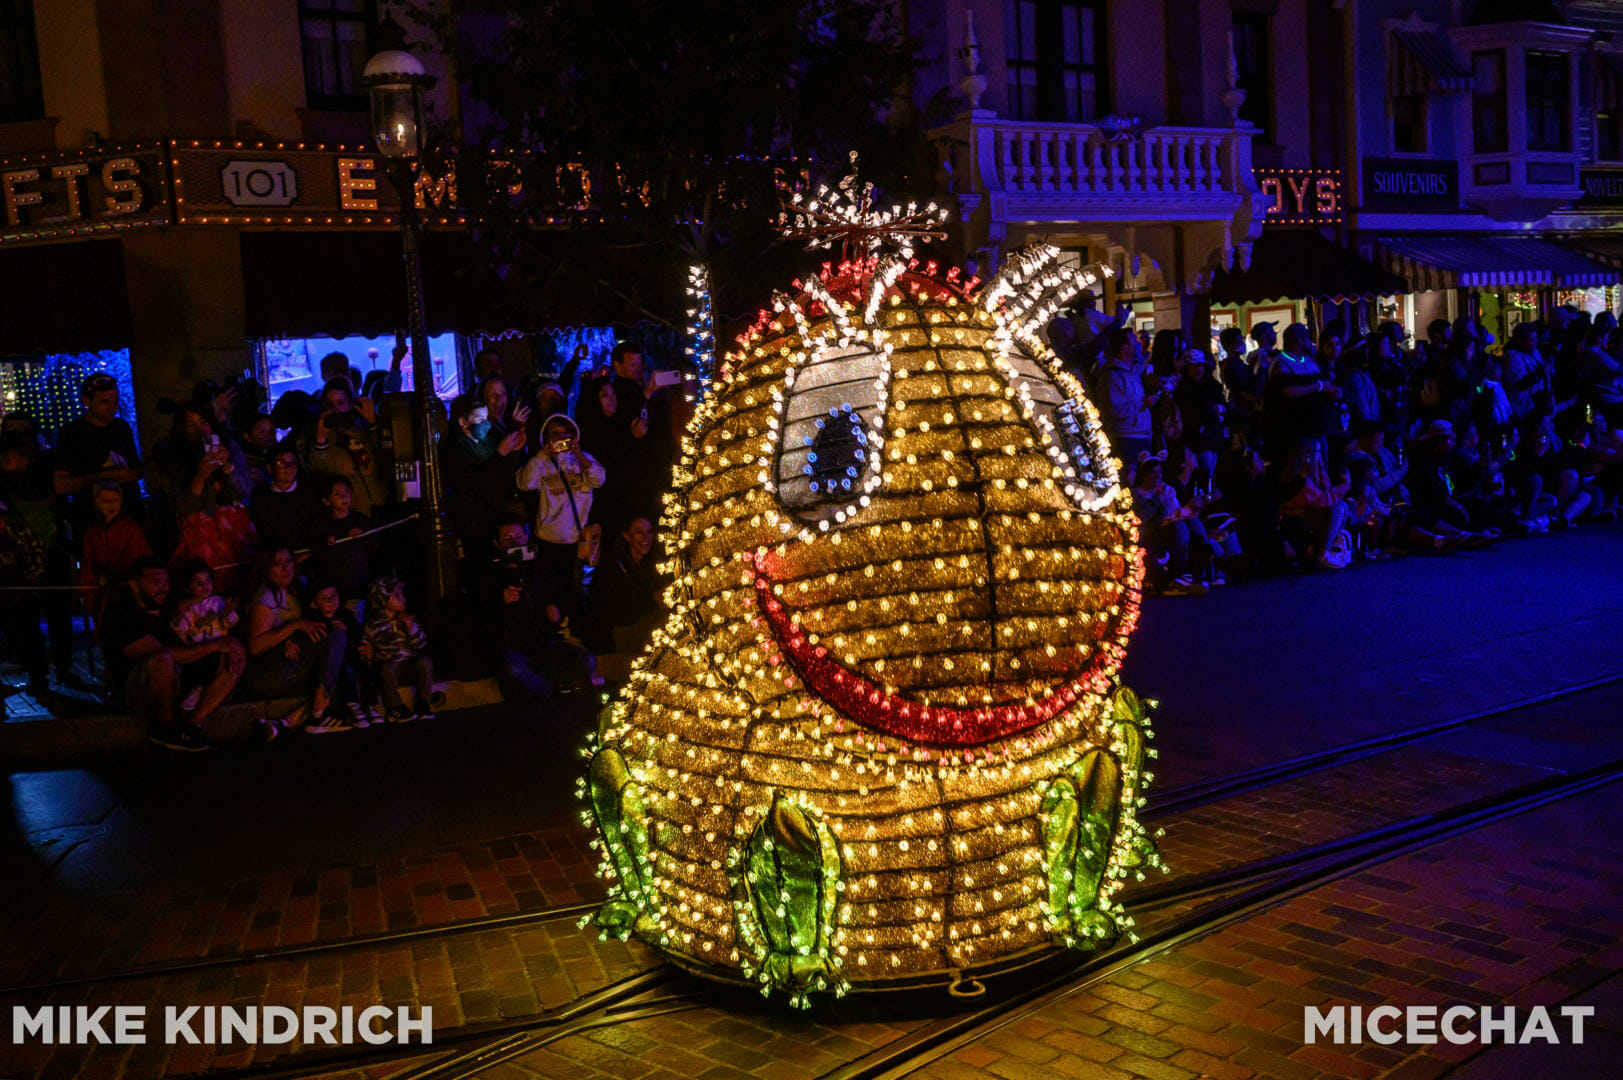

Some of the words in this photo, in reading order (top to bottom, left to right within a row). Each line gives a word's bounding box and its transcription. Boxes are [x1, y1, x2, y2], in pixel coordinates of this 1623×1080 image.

[1, 157, 144, 225] FTS
[231, 169, 288, 198] 101
[1373, 170, 1448, 195] SOUVENIRS
